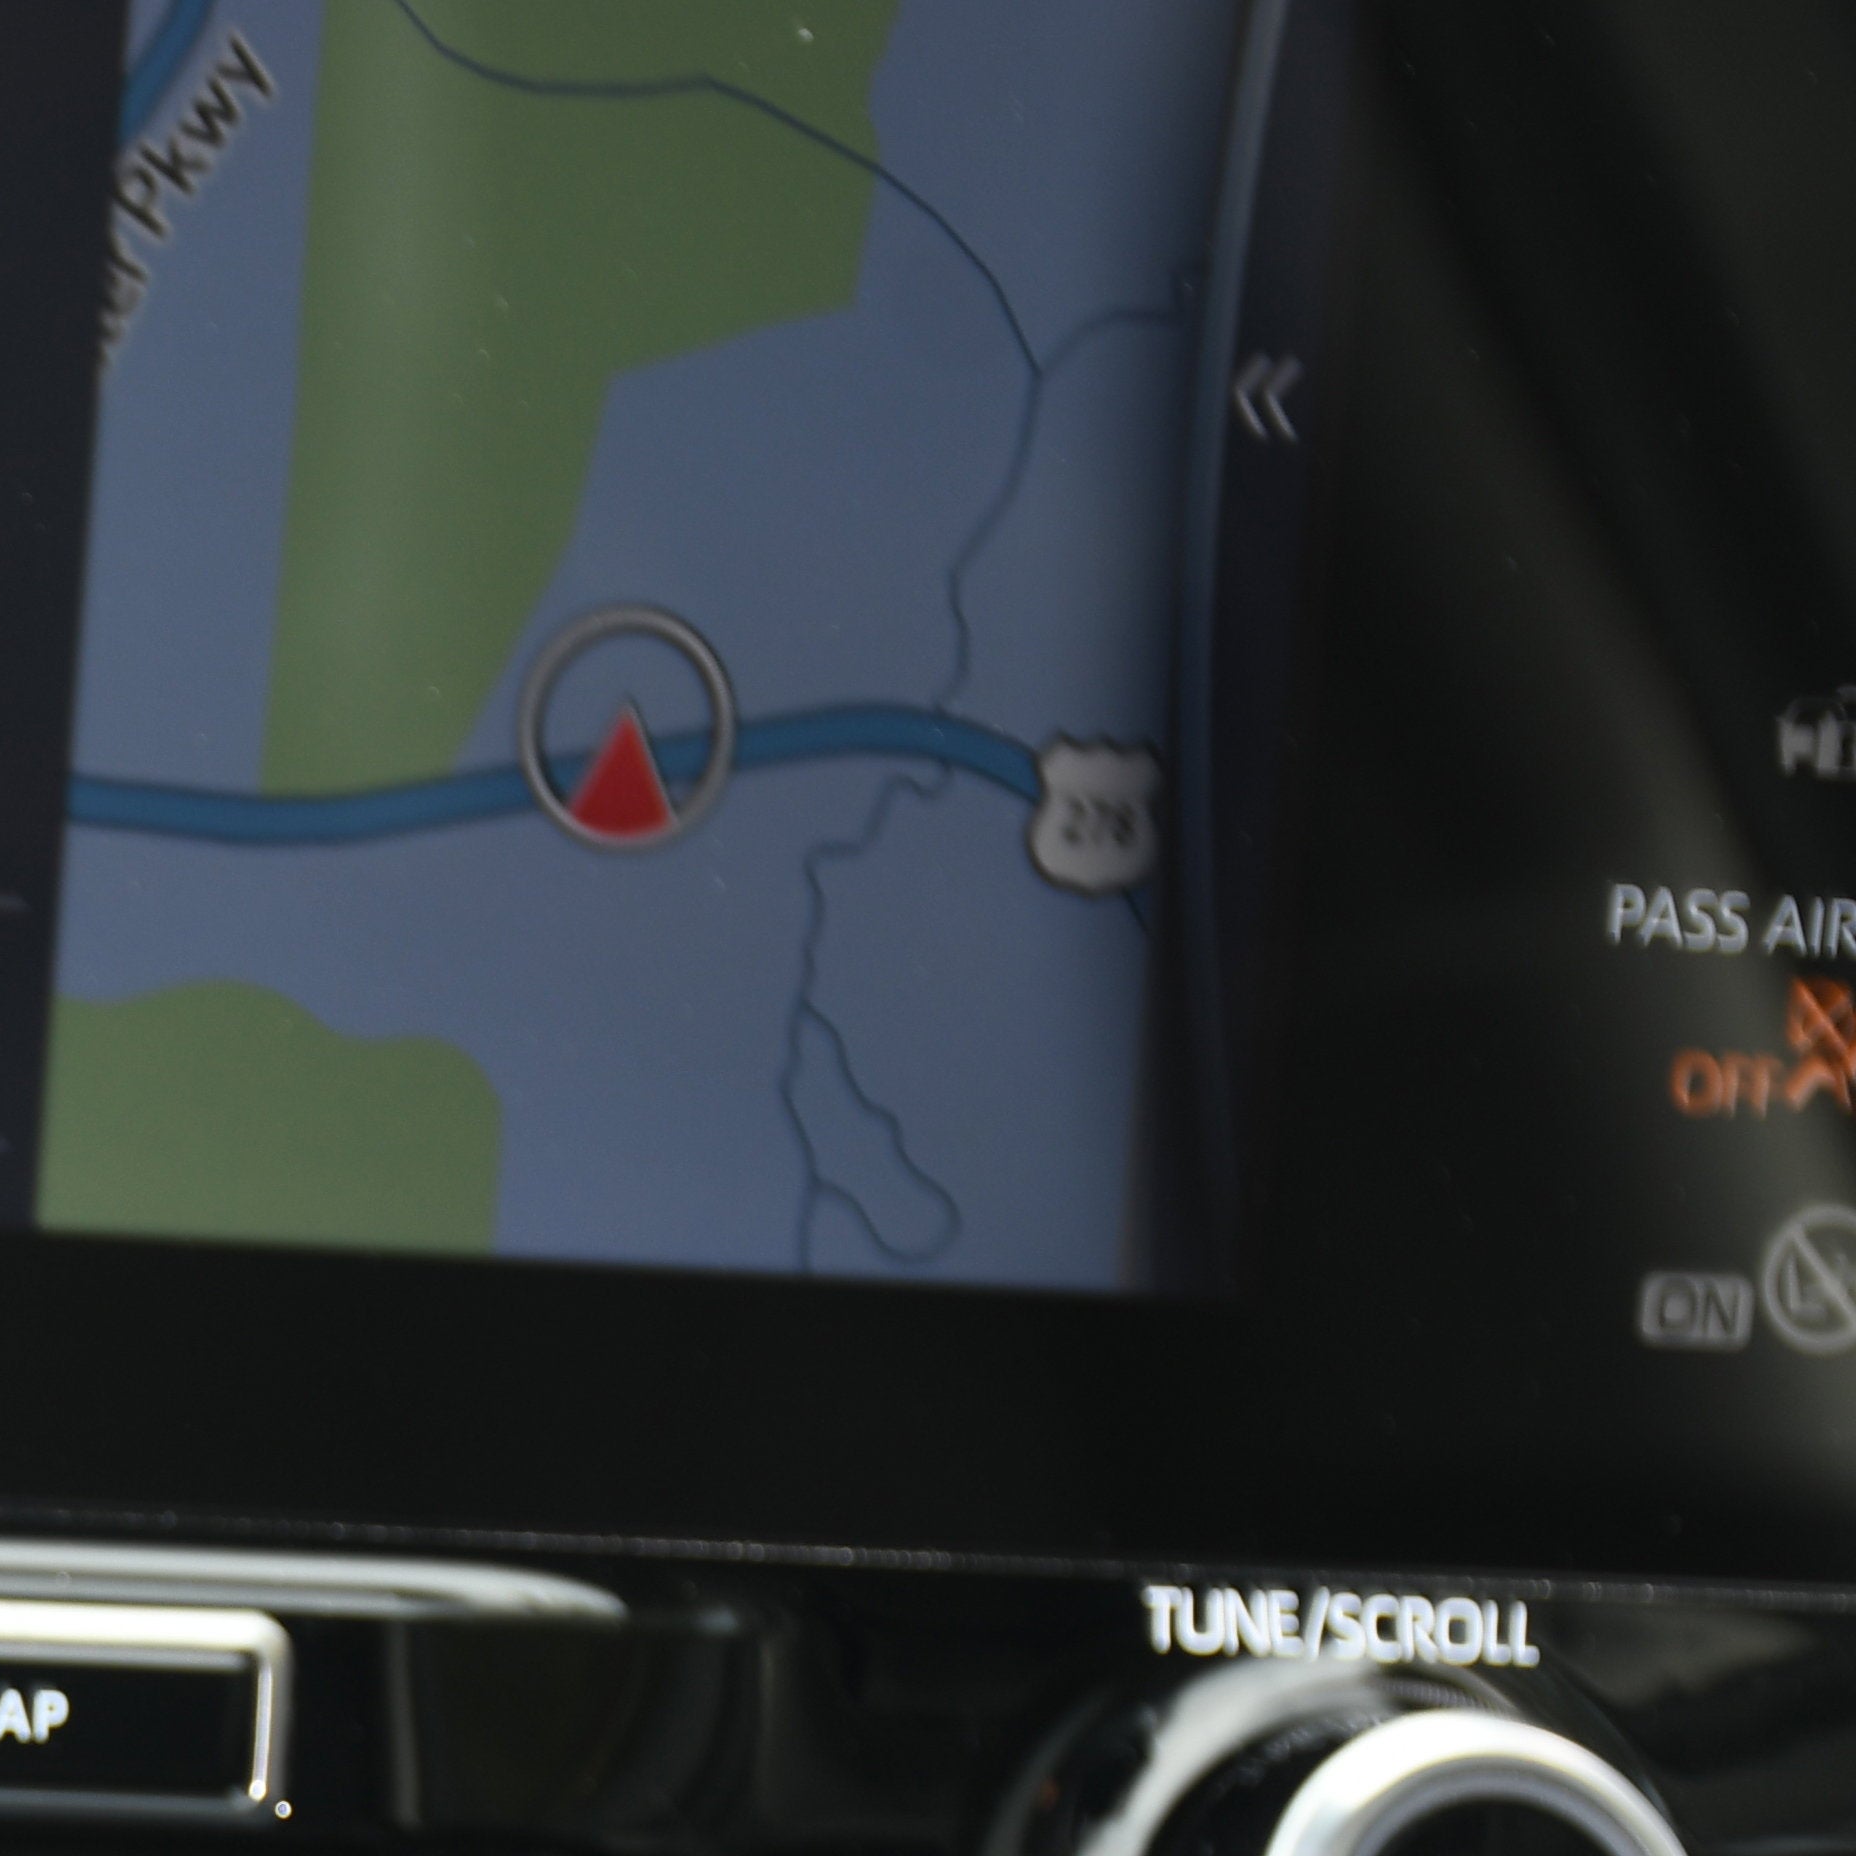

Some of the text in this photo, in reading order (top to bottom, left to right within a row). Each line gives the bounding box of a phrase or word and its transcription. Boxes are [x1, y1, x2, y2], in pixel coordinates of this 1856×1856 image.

[114, 34, 274, 240] Pkwy
[1607, 883, 1856, 959] PASS AIR
[1670, 1047, 1786, 1119] OFF
[1659, 1276, 1741, 1338] ON
[1143, 1584, 1540, 1667] TUNE/SCROLL
